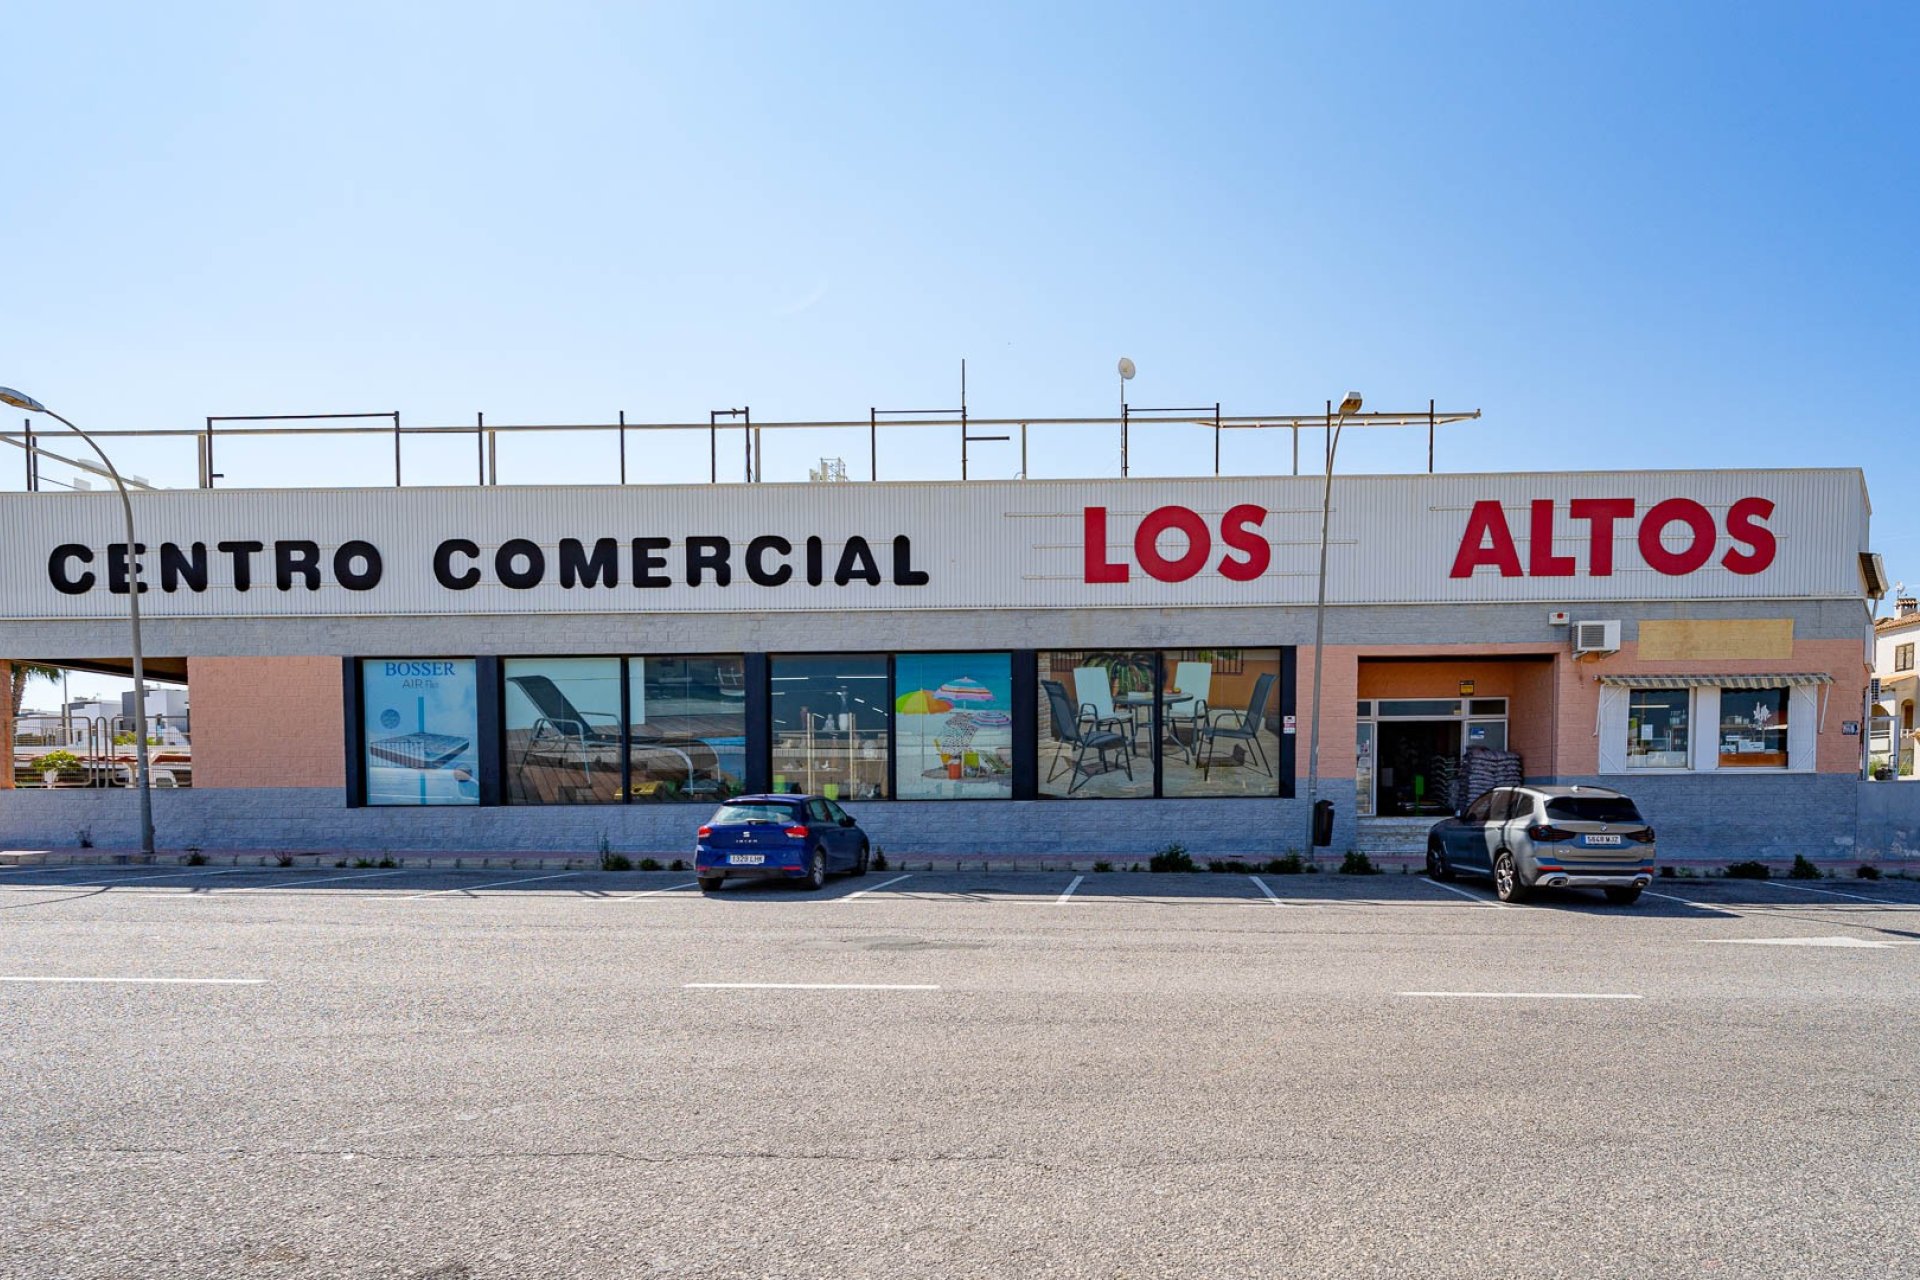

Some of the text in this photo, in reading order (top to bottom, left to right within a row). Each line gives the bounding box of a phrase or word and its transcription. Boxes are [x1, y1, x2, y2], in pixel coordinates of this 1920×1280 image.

[48, 498, 1776, 595] CENTRO COMERCIAL LOS ALTOS
[385, 661, 456, 676] BOSSER
